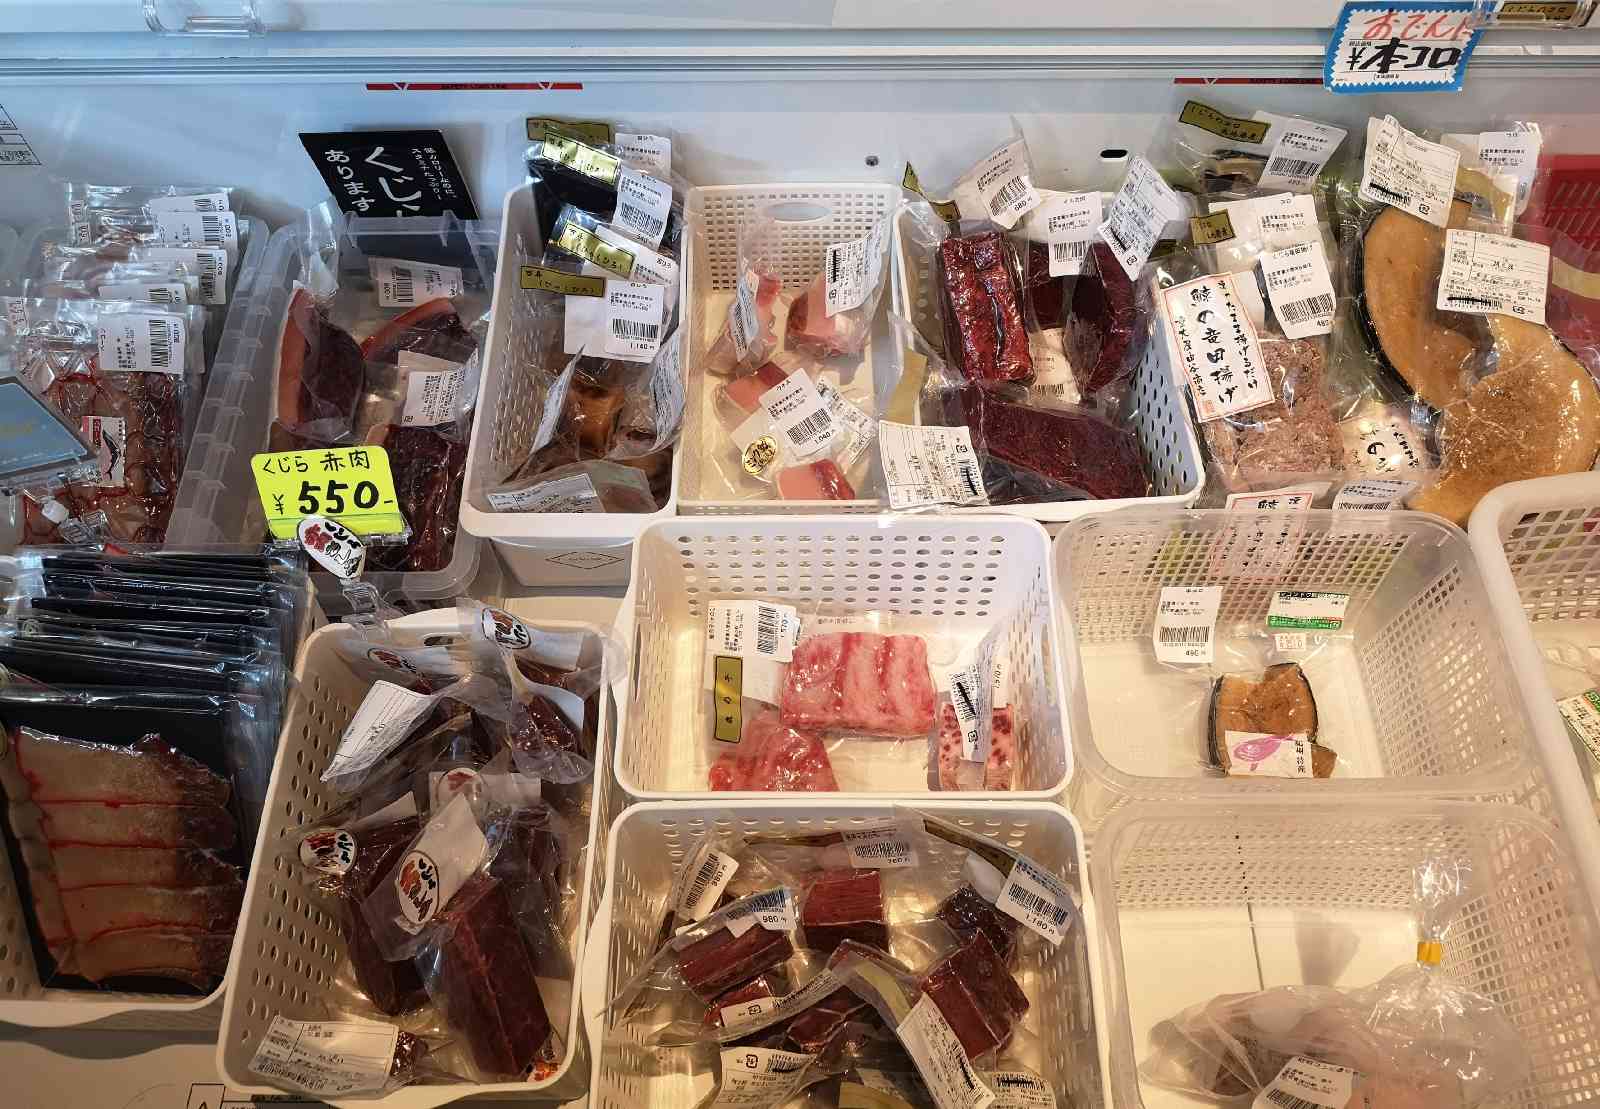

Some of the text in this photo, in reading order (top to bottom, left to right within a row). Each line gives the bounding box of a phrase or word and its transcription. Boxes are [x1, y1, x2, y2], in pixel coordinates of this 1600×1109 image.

[325, 149, 376, 212] あります
[365, 146, 422, 216] くじ
[1190, 285, 1239, 404] 鯨の竜田揚げ
[263, 450, 370, 474] くじら 赤肉
